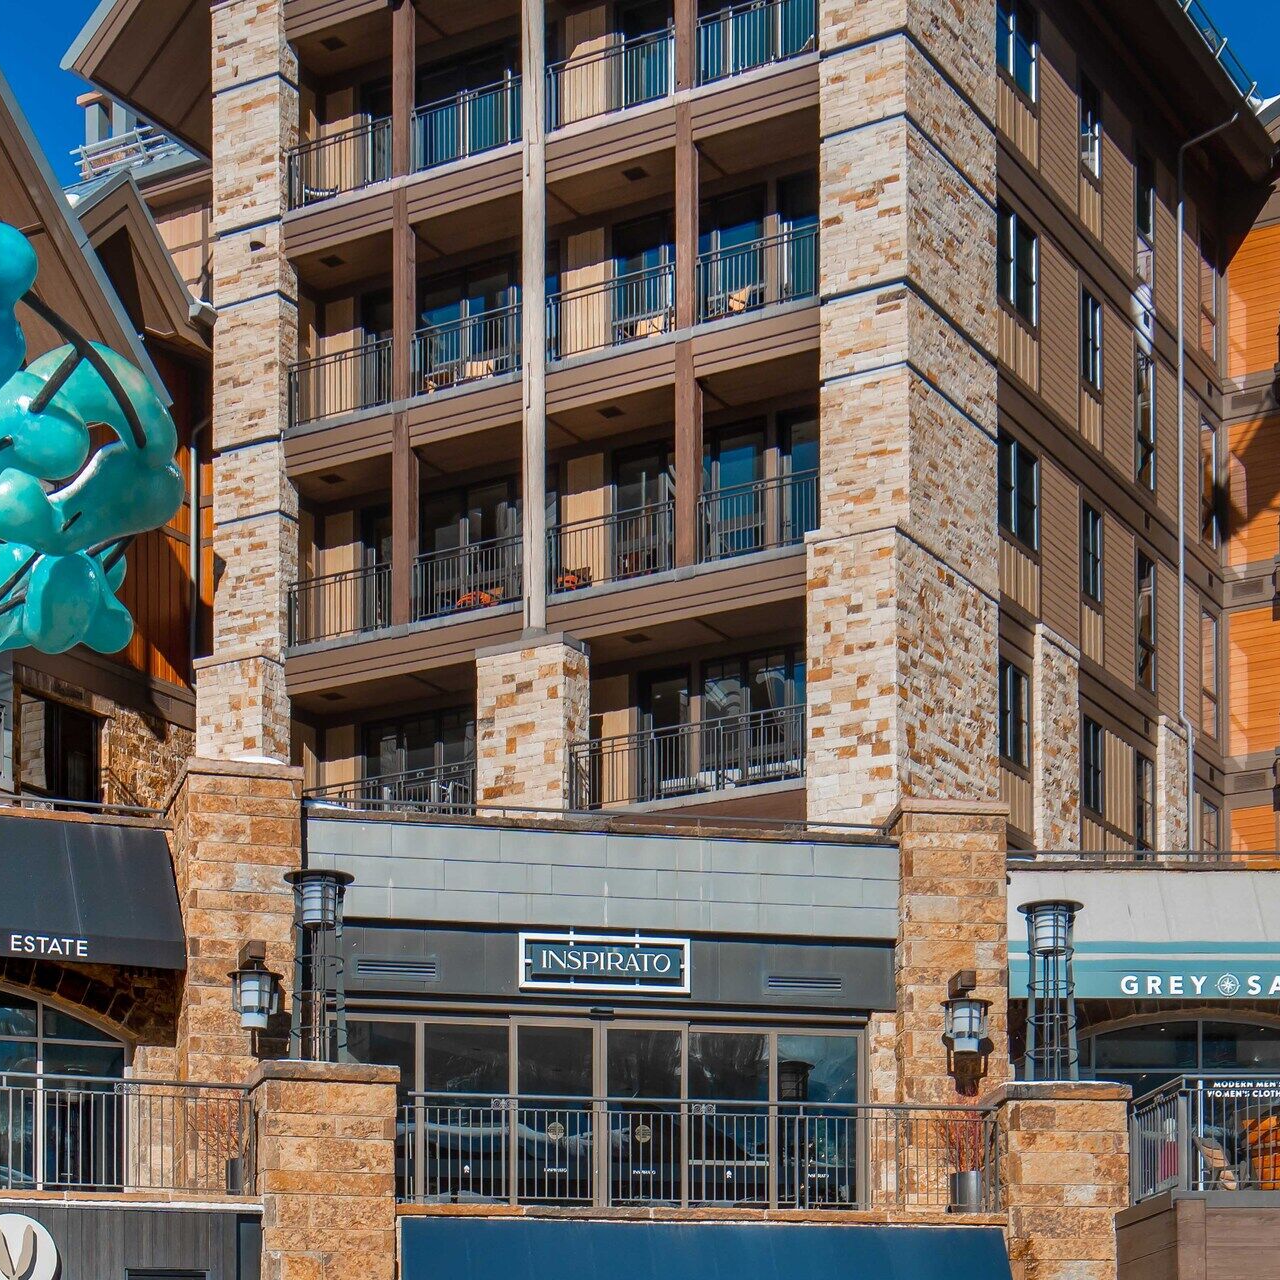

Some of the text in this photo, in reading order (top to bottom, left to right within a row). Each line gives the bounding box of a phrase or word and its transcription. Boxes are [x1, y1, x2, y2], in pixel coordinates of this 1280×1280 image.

[10, 934, 89, 957] ESTATE
[541, 949, 671, 973] INSPIRATO
[1120, 975, 1208, 995] GREY
[1213, 1080, 1254, 1088] MODERN
